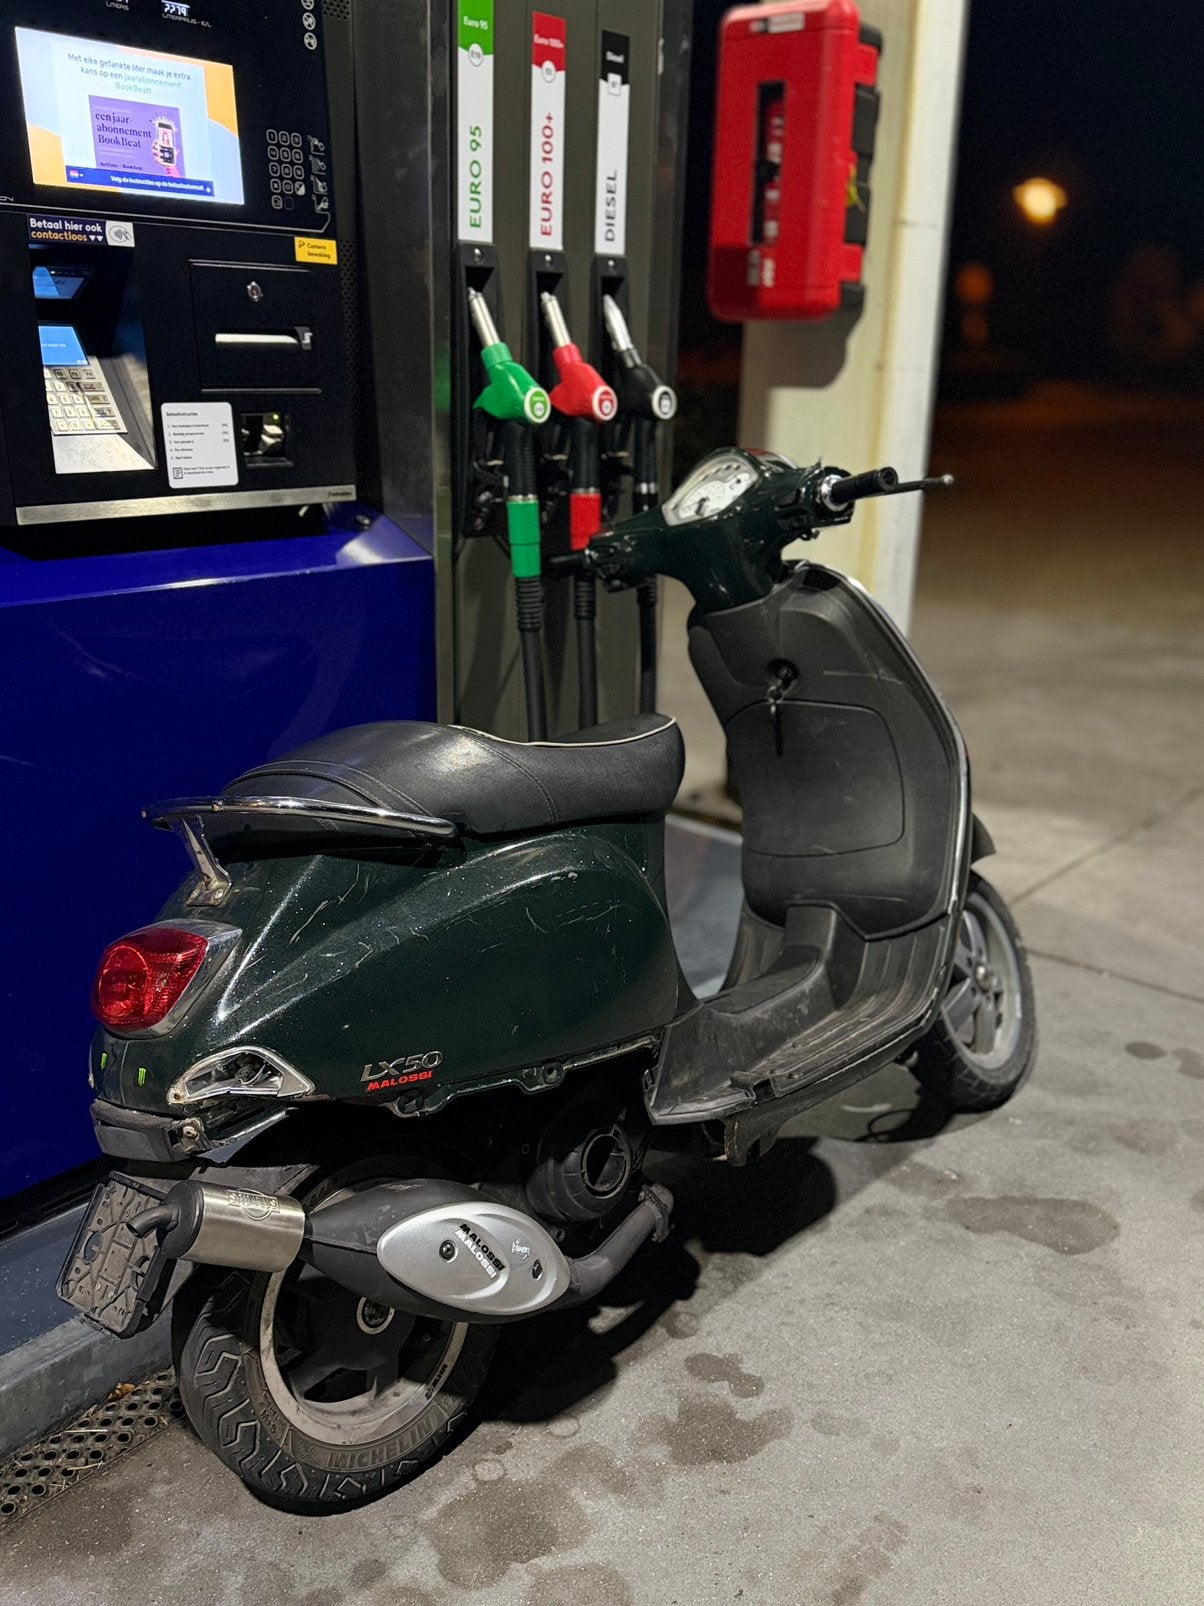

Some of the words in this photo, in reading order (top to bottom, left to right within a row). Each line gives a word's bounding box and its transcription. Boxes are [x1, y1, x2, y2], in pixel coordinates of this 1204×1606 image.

[464, 16, 480, 28] Euro
[480, 20, 488, 30] 95
[534, 33, 548, 46] Euro
[68, 53, 81, 62] Met
[84, 56, 98, 65] elke
[100, 59, 131, 71] getankte
[132, 63, 145, 73] liter
[147, 66, 165, 76] maak
[166, 69, 173, 78] je
[174, 72, 191, 81] extra
[81, 66, 98, 76] kans
[100, 70, 109, 78] op
[124, 73, 181, 89] jaarabonnement
[96, 124, 152, 139] abonnement
[98, 134, 142, 149] BookBeat
[470, 125, 482, 152] 95
[541, 113, 554, 163] 100+
[470, 160, 482, 229] EURO
[541, 171, 553, 237] EURO
[605, 169, 618, 242] DIESEL
[29, 218, 63, 230] Betaal
[64, 220, 83, 231] hier
[85, 223, 103, 233] ook
[31, 230, 88, 241] contactloos
[367, 1071, 433, 1091] MALOSSI
[454, 1229, 498, 1279] MALOSSI
[460, 1223, 506, 1272] MALOSSI
[328, 1416, 433, 1469] MICHELIN
